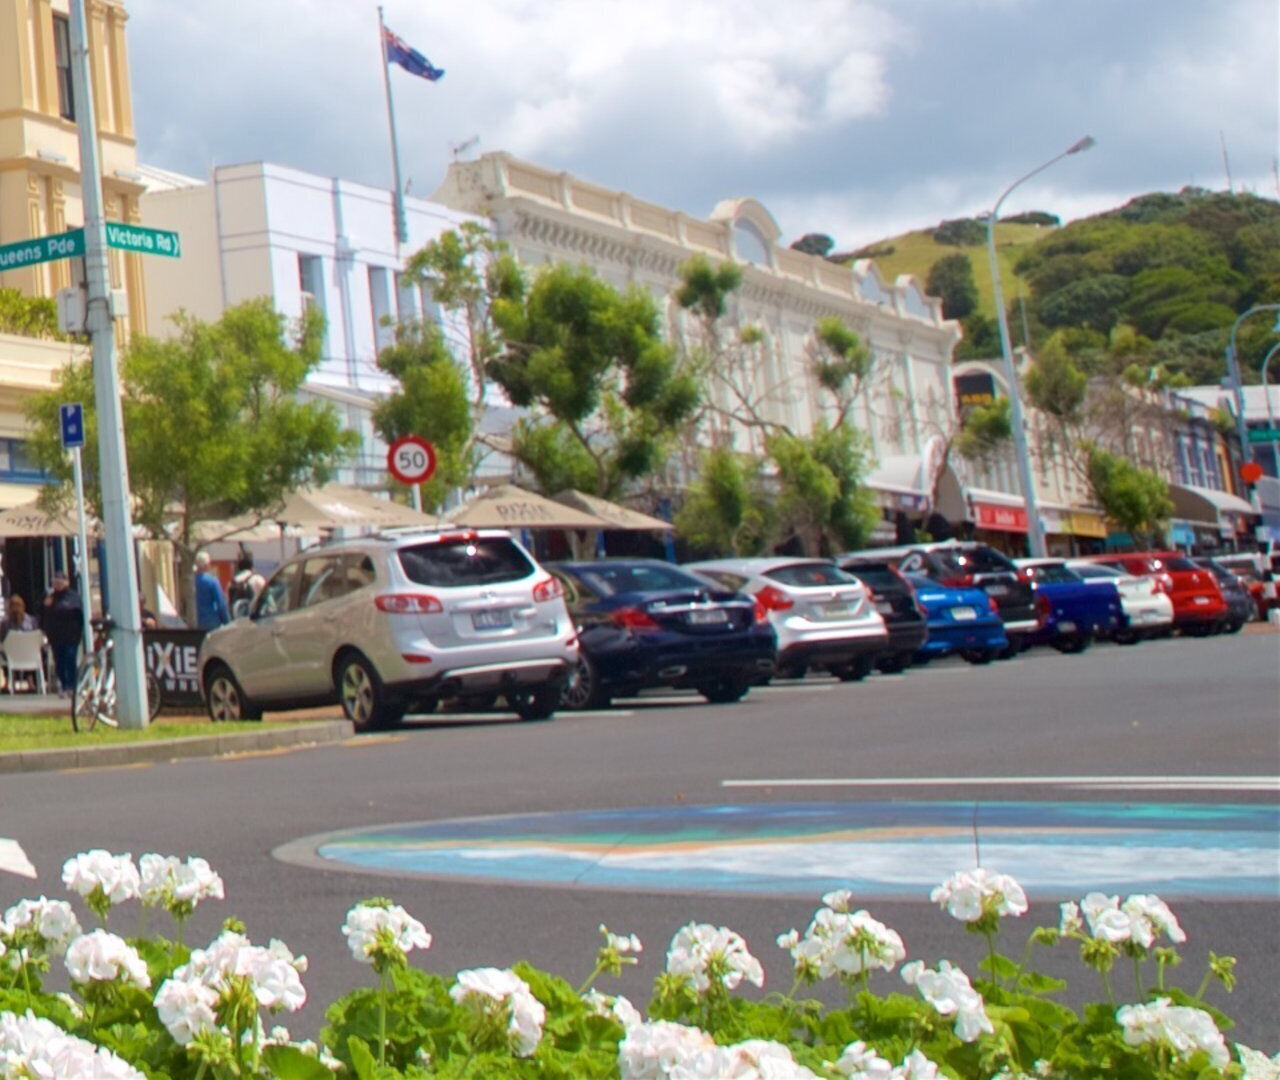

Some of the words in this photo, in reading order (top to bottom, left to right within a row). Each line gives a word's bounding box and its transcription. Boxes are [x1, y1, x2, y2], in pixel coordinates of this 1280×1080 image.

[48, 237, 75, 256] Pde
[107, 226, 153, 248] Victoria
[155, 233, 171, 252] Rd
[400, 450, 425, 470] 50
